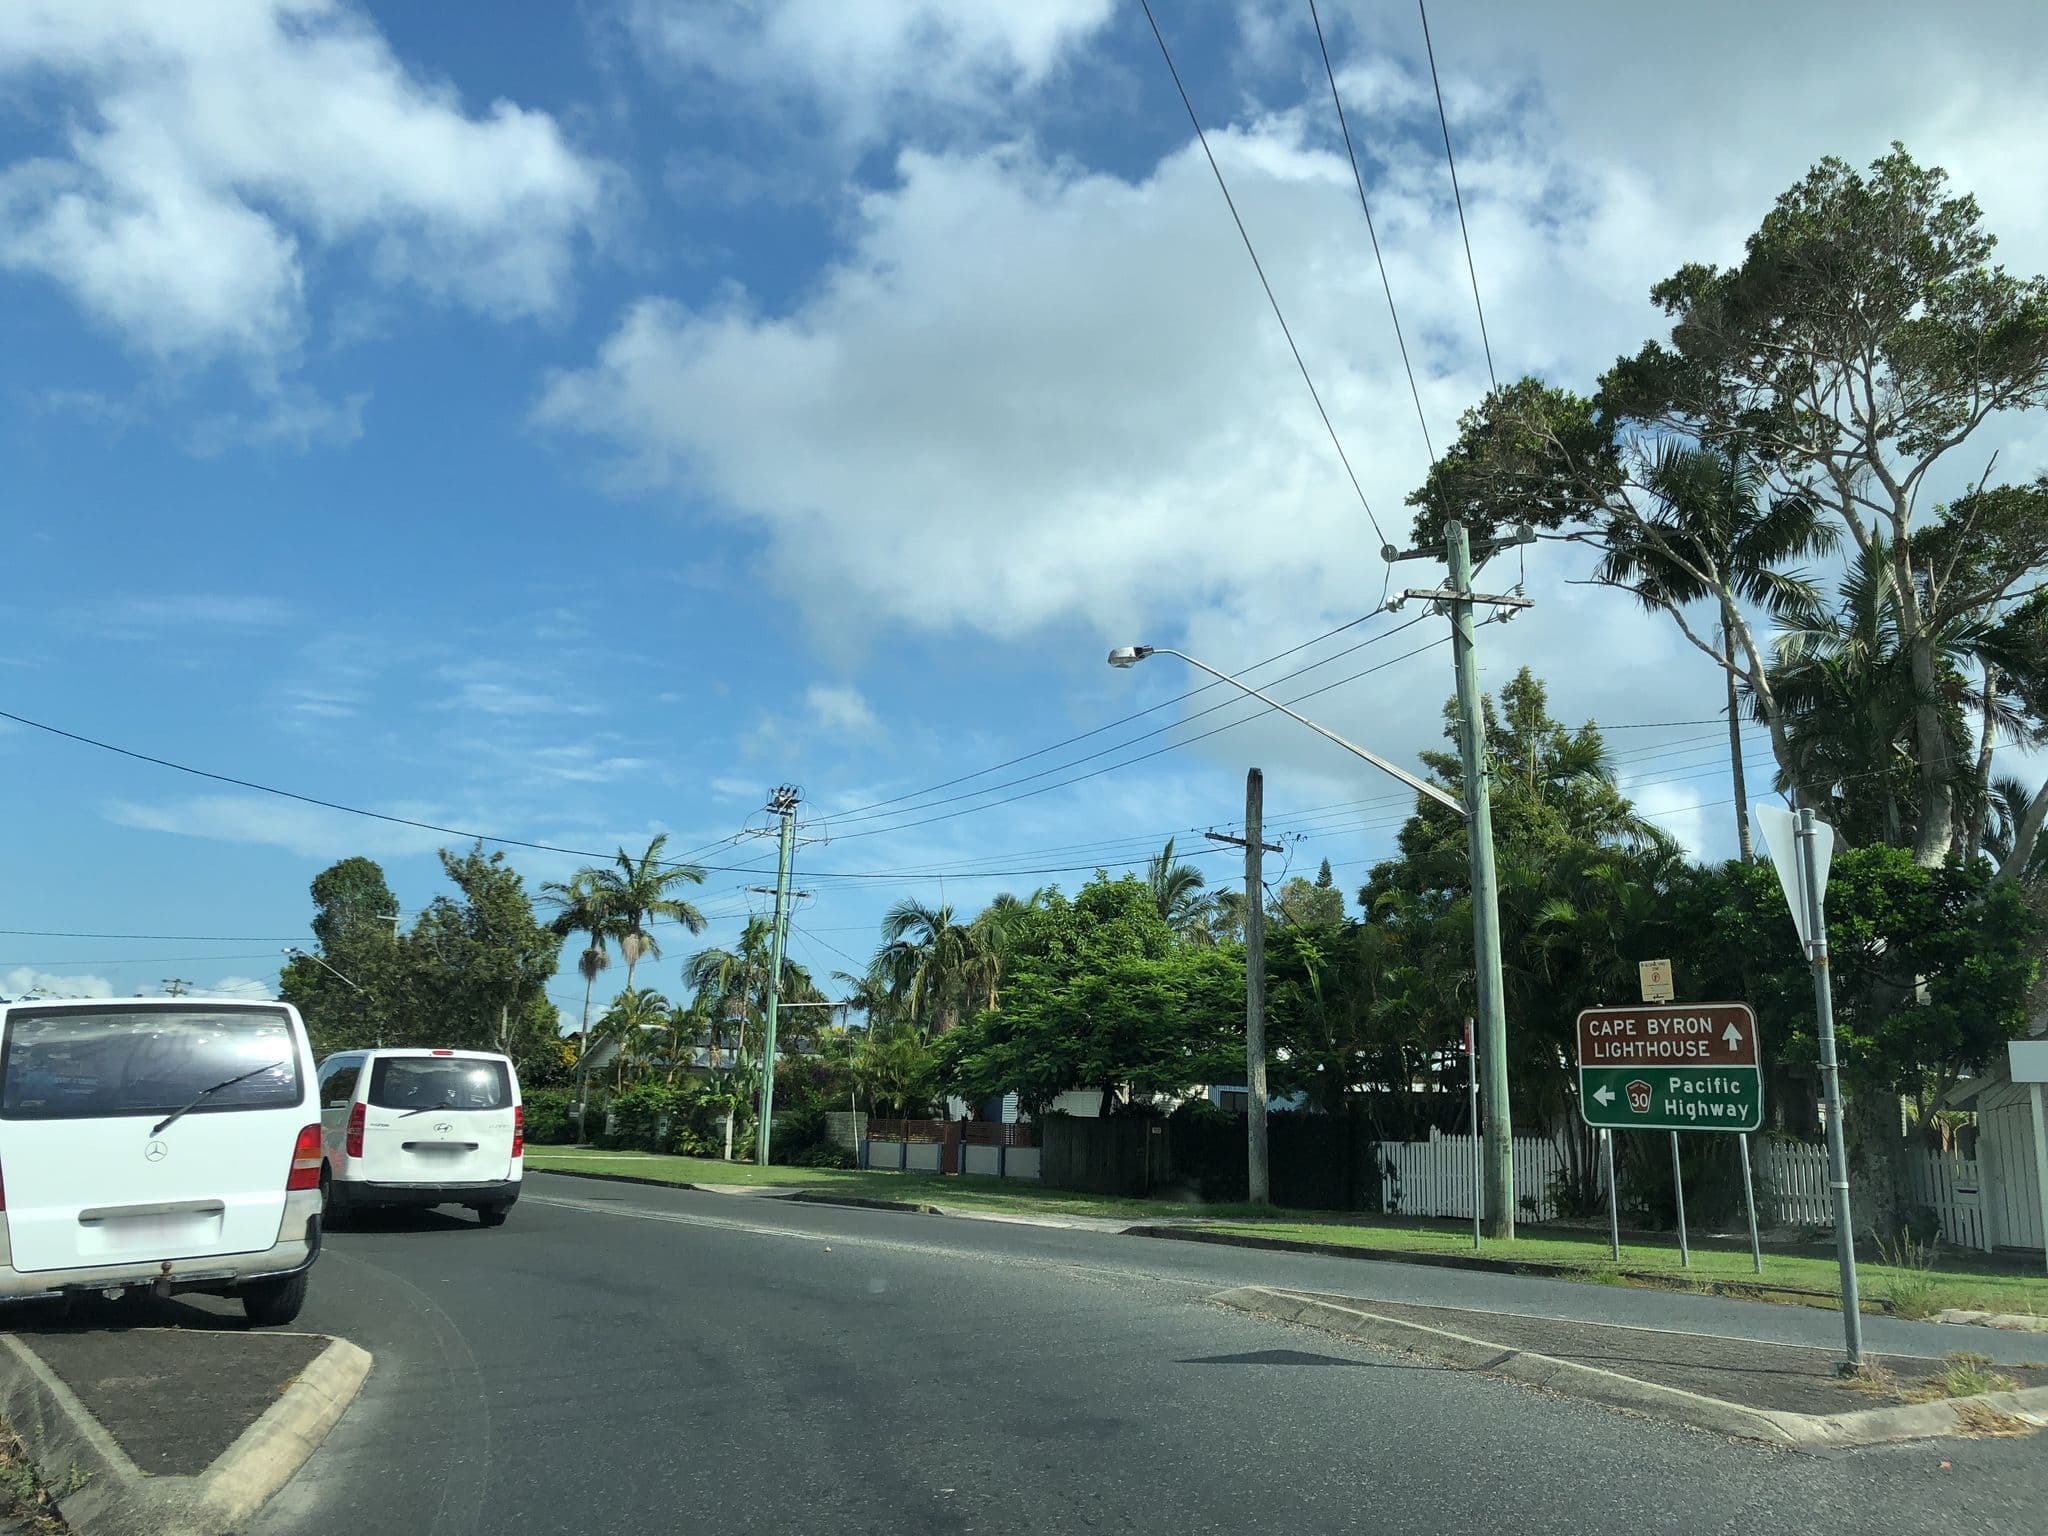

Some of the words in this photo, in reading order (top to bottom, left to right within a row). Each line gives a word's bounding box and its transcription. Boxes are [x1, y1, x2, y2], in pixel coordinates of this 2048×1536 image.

[1589, 1019, 1637, 1036] CAPE
[1647, 1017, 1713, 1035] BYRON
[1594, 1040, 1710, 1058] LIGHTHOUSE
[1669, 1077, 1741, 1094] Pacific
[1631, 1093, 1648, 1107] 30
[1664, 1099, 1749, 1121] Highway
